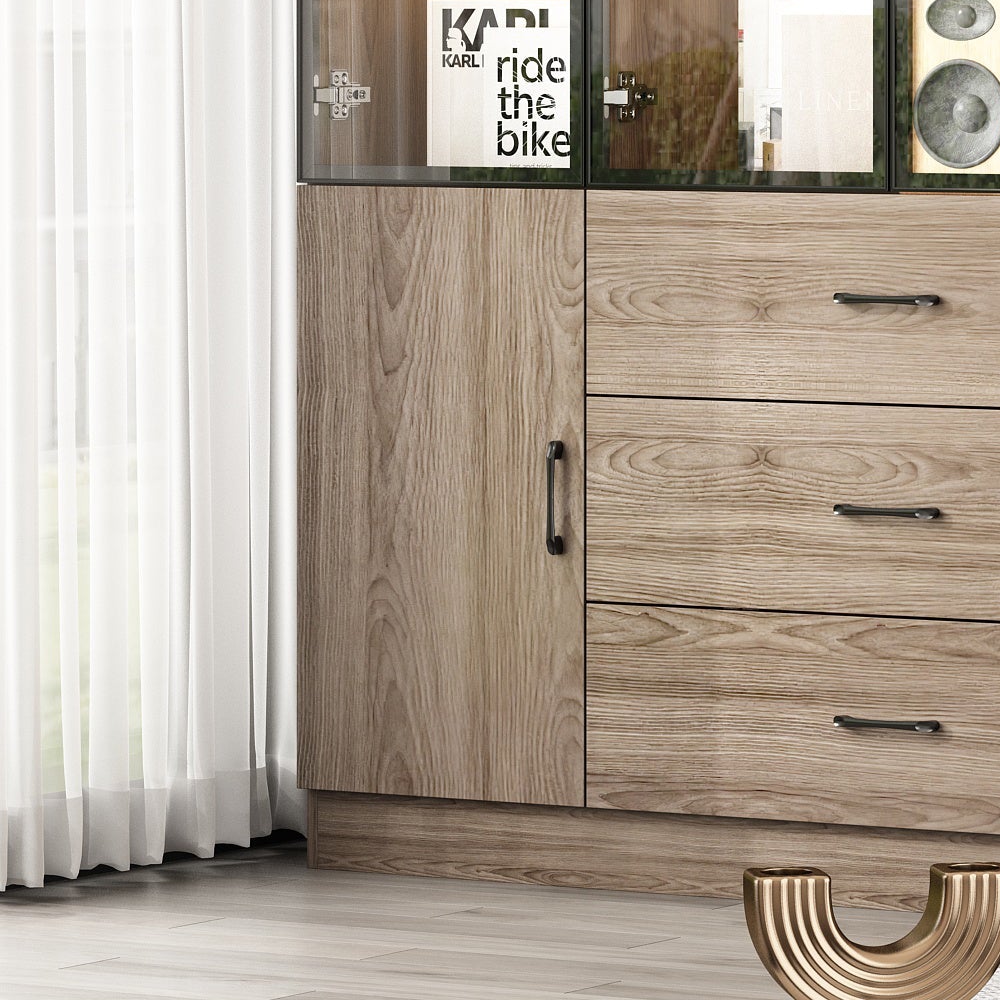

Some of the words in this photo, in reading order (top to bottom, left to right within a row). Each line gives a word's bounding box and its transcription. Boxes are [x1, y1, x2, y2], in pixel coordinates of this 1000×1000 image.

[442, 54, 480, 68] KARL
[497, 48, 566, 83] ride
[497, 84, 556, 120] the
[497, 121, 571, 157] bike
